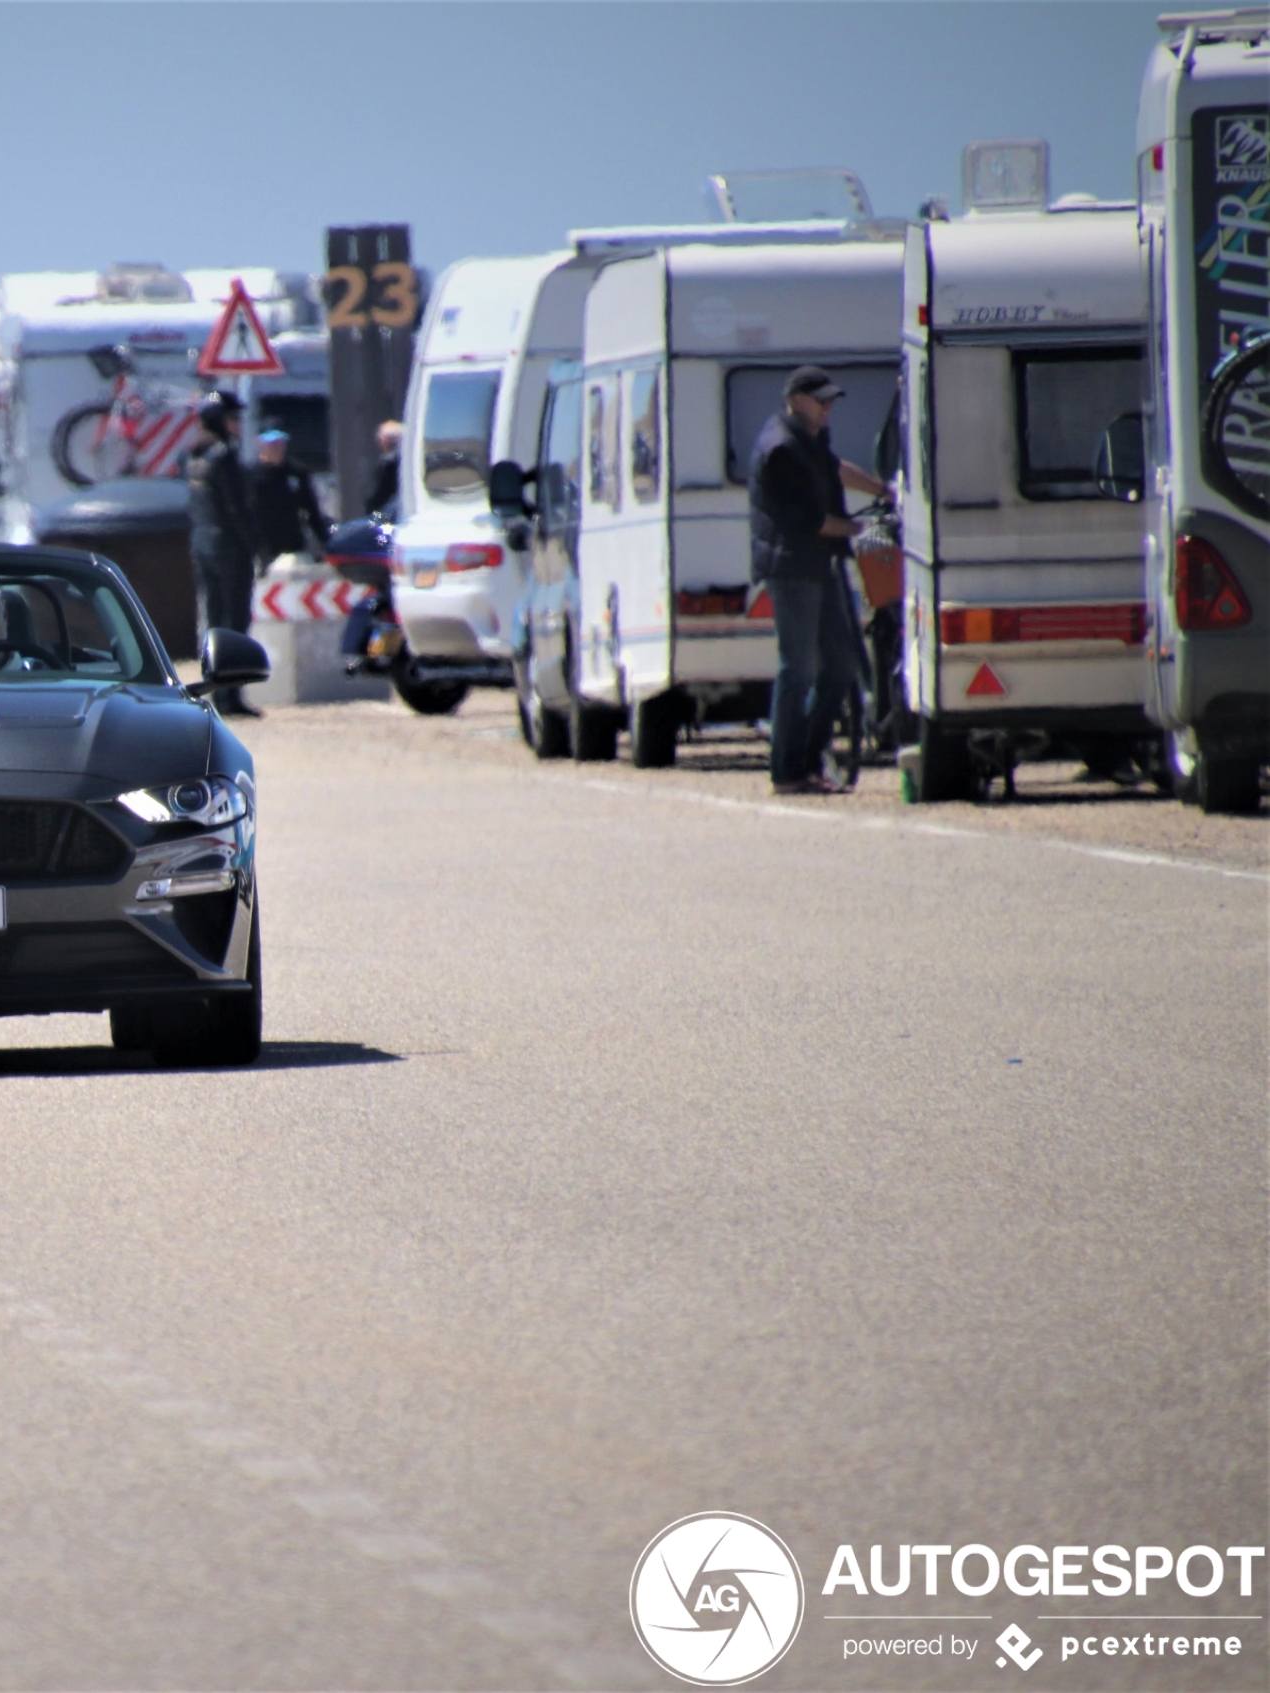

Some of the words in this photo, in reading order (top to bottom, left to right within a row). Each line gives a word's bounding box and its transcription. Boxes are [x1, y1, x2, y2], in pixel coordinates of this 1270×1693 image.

[1216, 168, 1270, 183] KNAUS
[323, 262, 418, 328] 23
[954, 305, 1046, 325] HOBBY
